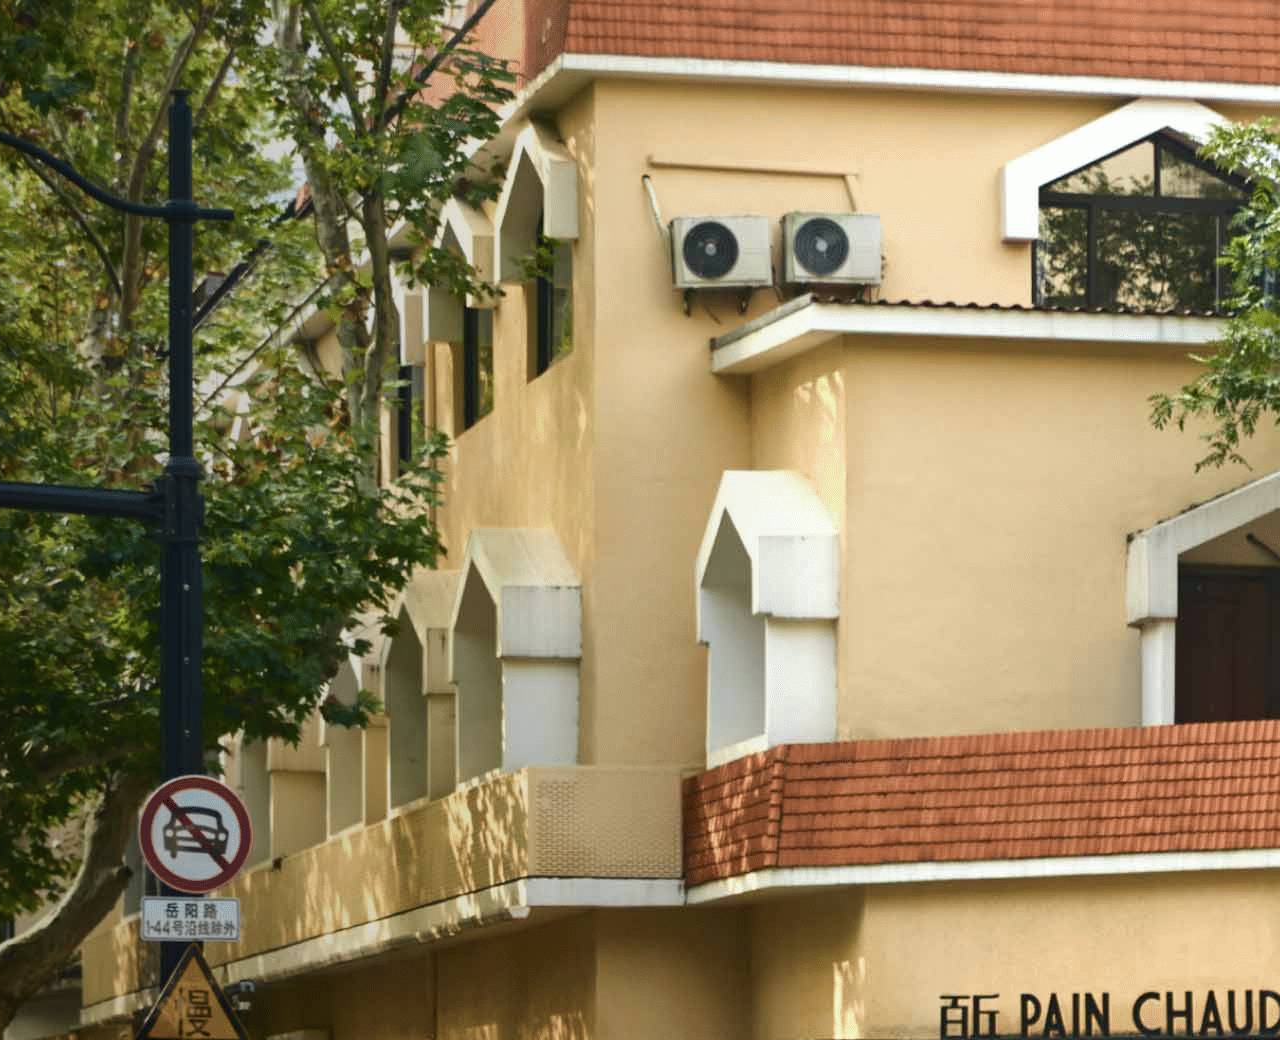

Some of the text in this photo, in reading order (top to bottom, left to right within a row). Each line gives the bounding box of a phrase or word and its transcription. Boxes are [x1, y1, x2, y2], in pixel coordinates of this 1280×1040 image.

[165, 902, 217, 919] 岳阳路
[174, 987, 212, 1037] 慢
[1020, 992, 1110, 1037] PAIN
